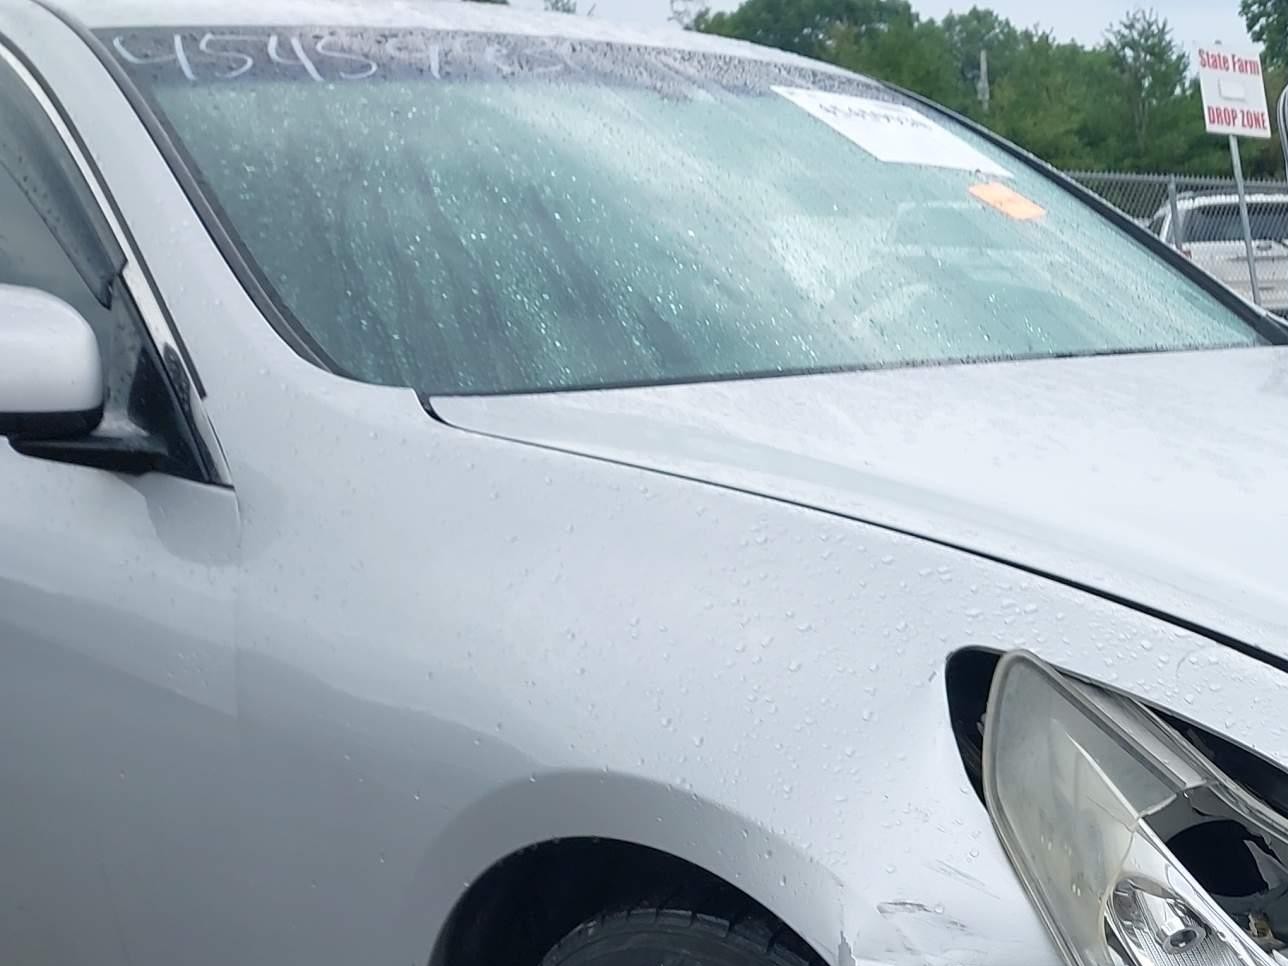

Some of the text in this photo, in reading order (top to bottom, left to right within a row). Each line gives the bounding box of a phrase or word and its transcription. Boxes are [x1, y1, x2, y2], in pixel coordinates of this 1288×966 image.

[1198, 48, 1260, 76] State Farm
[1207, 105, 1267, 130] DROP ZONE
